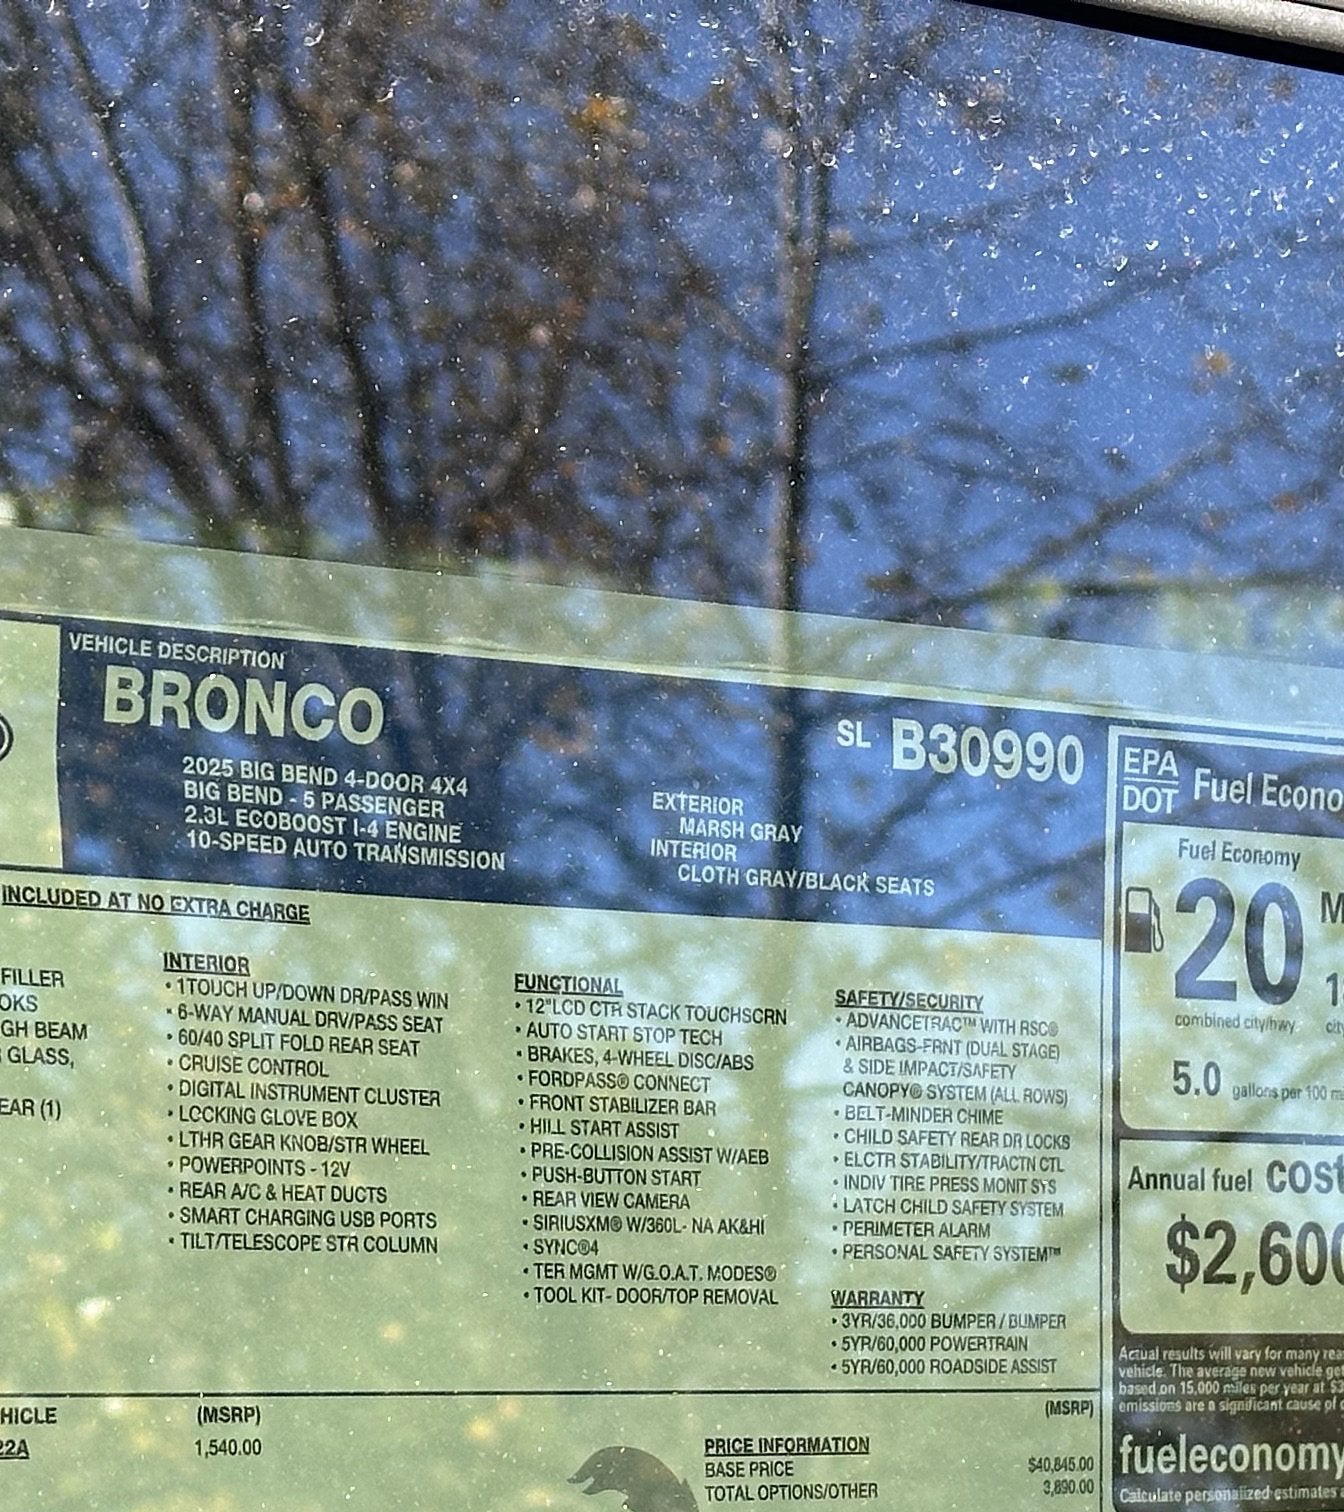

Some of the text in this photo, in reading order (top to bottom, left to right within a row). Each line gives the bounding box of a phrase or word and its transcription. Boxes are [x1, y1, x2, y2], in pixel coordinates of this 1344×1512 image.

[68, 633, 287, 670] VEHICLE DESCRIPTION
[104, 666, 383, 744] BRONCO
[837, 718, 1084, 784] SL B30990
[1124, 747, 1179, 777] EPA
[181, 757, 468, 796] 2025 BIG BEND 4-DOOR 4X4
[1194, 769, 1252, 805] Fuel
[651, 793, 744, 815] EXTERIOR
[1123, 785, 1179, 814] DOT
[679, 818, 806, 843] MARSH GRAY
[186, 829, 506, 870] 10-SPEED AUTO TRANSMISSION
[650, 840, 737, 861] INTERIOR
[1178, 838, 1300, 871] Fuel Economy
[677, 865, 935, 895] CLOTH GRAY/BLACK SEATS
[1, 884, 102, 909] INCLUDED
[107, 891, 132, 911] AT
[137, 893, 165, 913] NO
[169, 895, 232, 917] EXTRA
[235, 899, 310, 922] CHARGE
[1175, 877, 1304, 1006] 20
[162, 954, 250, 973] INTERIOR
[0, 967, 64, 986] FILLER
[514, 975, 623, 994] FUNCTIONAL
[834, 990, 983, 1011] SAFETY/SECURITY
[1172, 1060, 1221, 1097] 5.0
[844, 1106, 1004, 1125] BELT-MINDER CHIME
[531, 1168, 699, 1187] PUSH-BUTTON START
[1128, 1166, 1206, 1192] Annual
[1213, 1168, 1252, 1192] fuel
[829, 1290, 925, 1305] WARRANTY
[840, 1336, 1028, 1351] 5YR/60,000 POWERTRAIN
[194, 1439, 262, 1458] 1,540.00
[704, 1437, 870, 1453] PRICE INFORMATION
[704, 1461, 794, 1477] BASE PRICE
